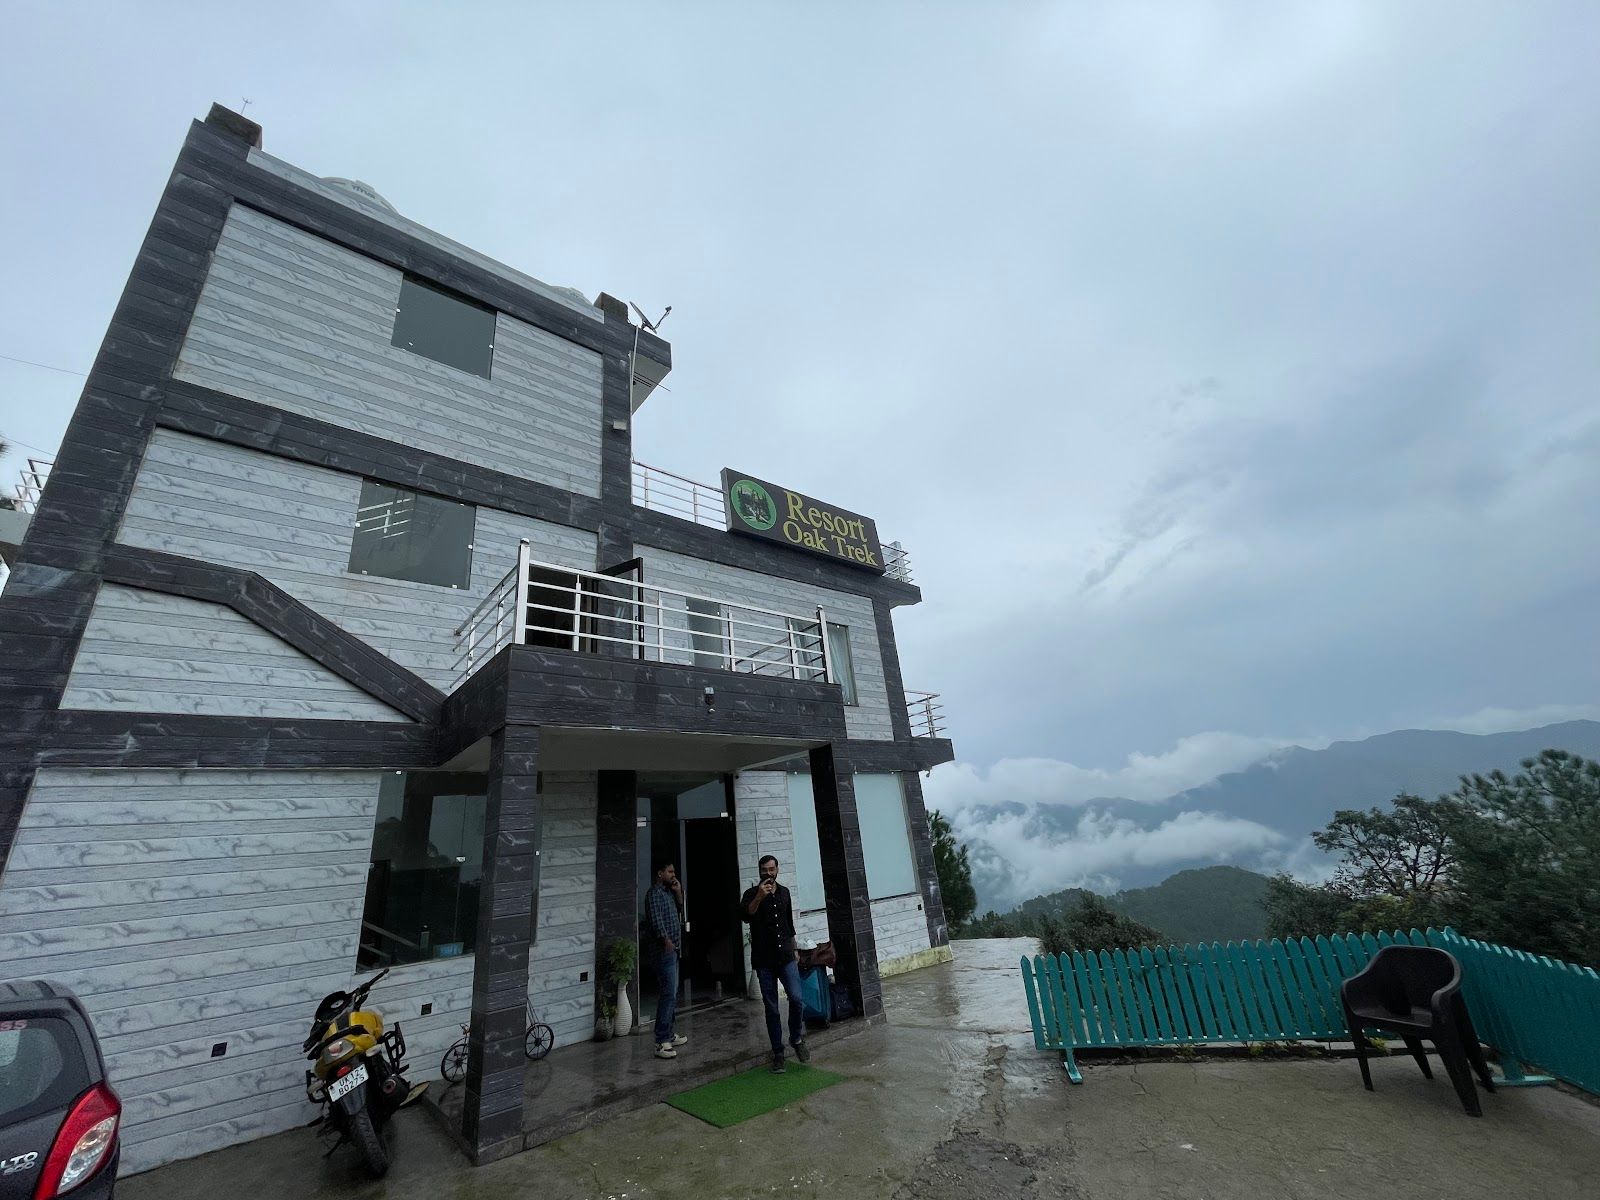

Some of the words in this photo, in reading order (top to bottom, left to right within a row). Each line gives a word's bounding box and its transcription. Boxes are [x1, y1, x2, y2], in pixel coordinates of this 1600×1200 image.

[784, 490, 868, 543] Resort
[783, 520, 829, 552] Oak
[831, 534, 879, 566] Trek
